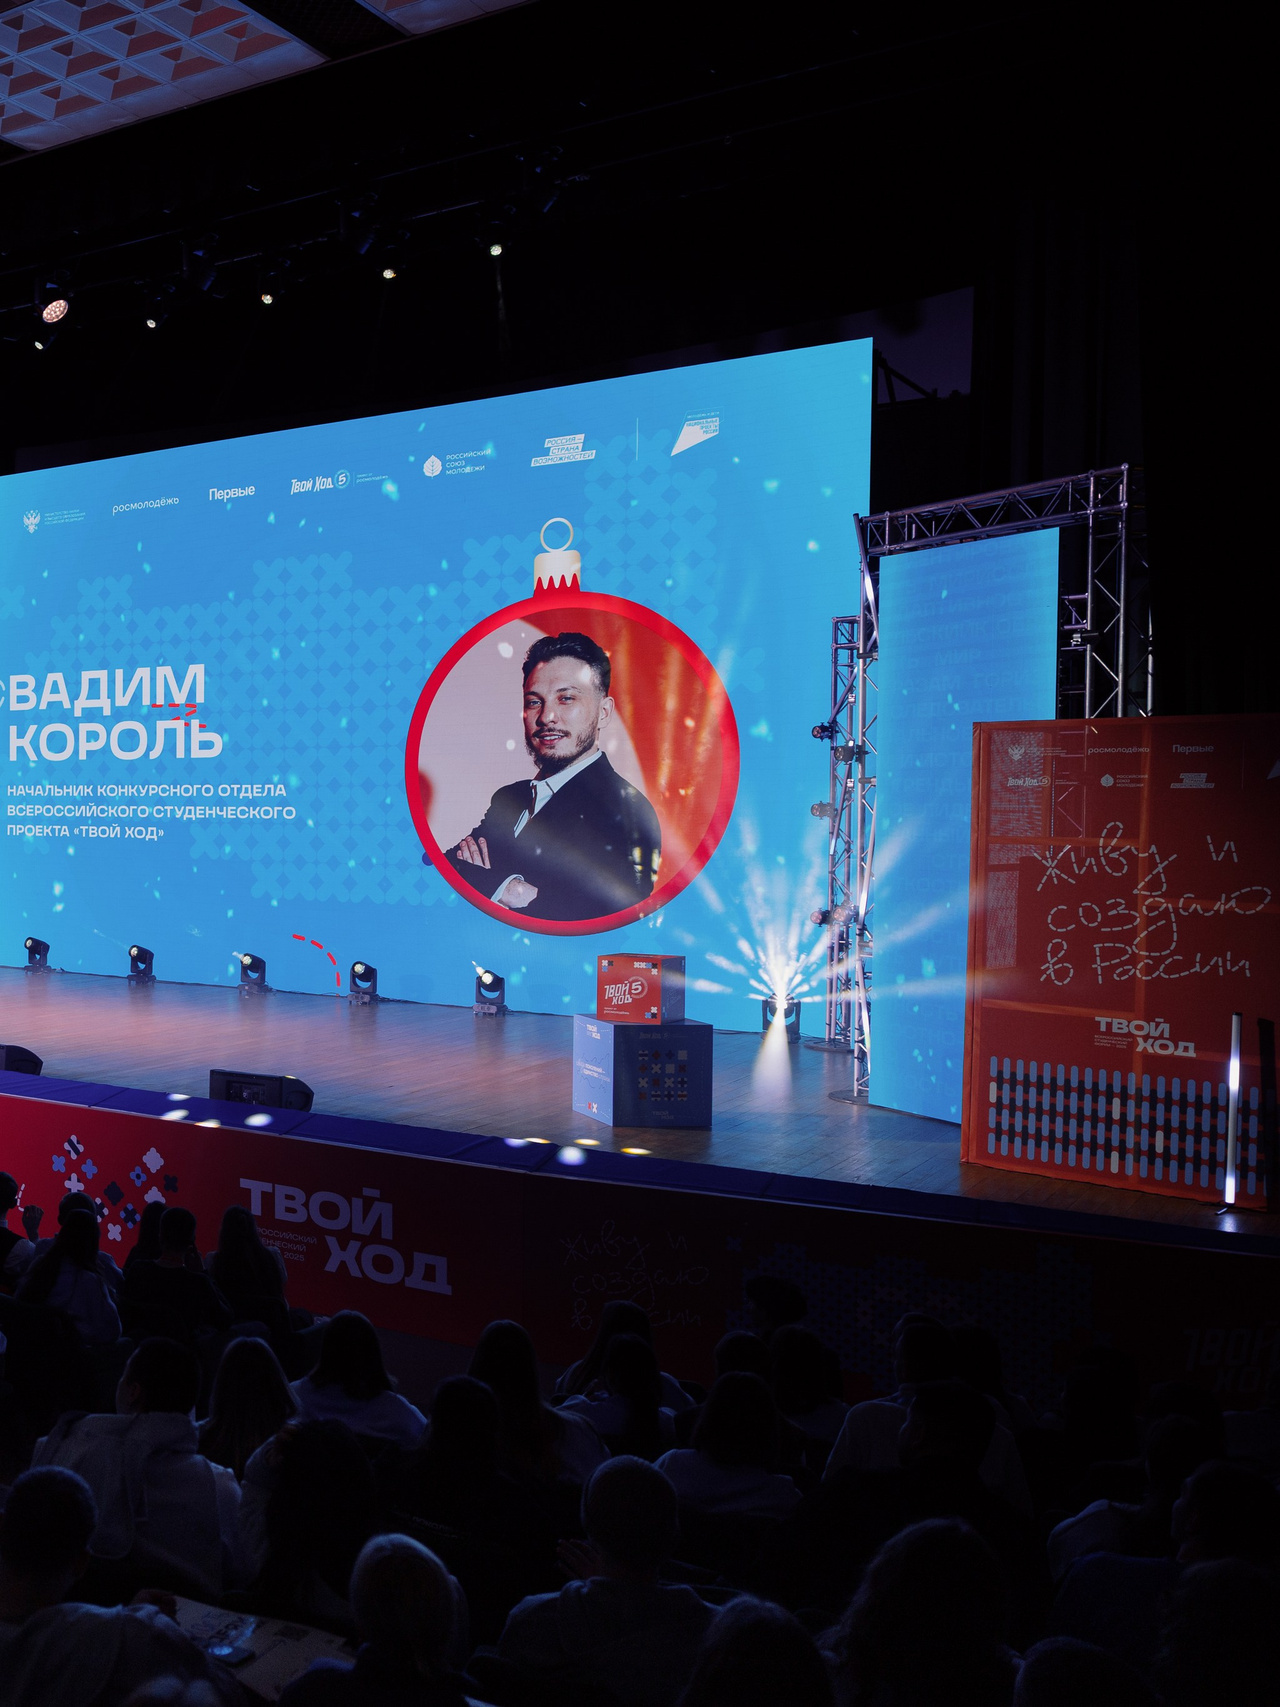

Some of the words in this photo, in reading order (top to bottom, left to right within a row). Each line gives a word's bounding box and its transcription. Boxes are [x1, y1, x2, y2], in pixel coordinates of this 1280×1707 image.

[546, 436, 576, 446] РОССИЯ
[446, 448, 491, 460] РОССИЙСКИЙ
[551, 445, 580, 455] СТРАНА
[446, 460, 466, 468] СОЮЗ
[533, 452, 594, 466] ВОЗМОЖНОСТЕЙ
[209, 485, 256, 502] Первые
[112, 497, 180, 516] росмолодёжь
[9, 664, 205, 717] ВАДИМ
[9, 719, 223, 761] КОРОЛЬ
[1172, 744, 1214, 755] Первые
[7, 785, 94, 797] НАЧАЛЬНИК
[97, 784, 214, 797] КОНКУРСНОГО
[218, 784, 287, 799] ОТДЕЛА
[7, 803, 149, 818] ВСЕРОССИЙСКОГО
[153, 806, 296, 820] СТУДЕНЧЕСКОГО
[7, 825, 70, 837] ПРОЕКТА
[73, 823, 121, 838] «ТВОЙ
[124, 826, 164, 841] ХОД»
[1048, 886, 1272, 956] создаю
[1092, 943, 1251, 984] России
[604, 981, 630, 1000] ТВОЙ
[612, 994, 632, 1005] ХОД
[1095, 1016, 1170, 1038] ТВОЙ
[1136, 1036, 1196, 1058] ХОД
[239, 1177, 393, 1241] ТВОЙ
[284, 1251, 305, 1262] 2025
[324, 1234, 453, 1296] ХОД
